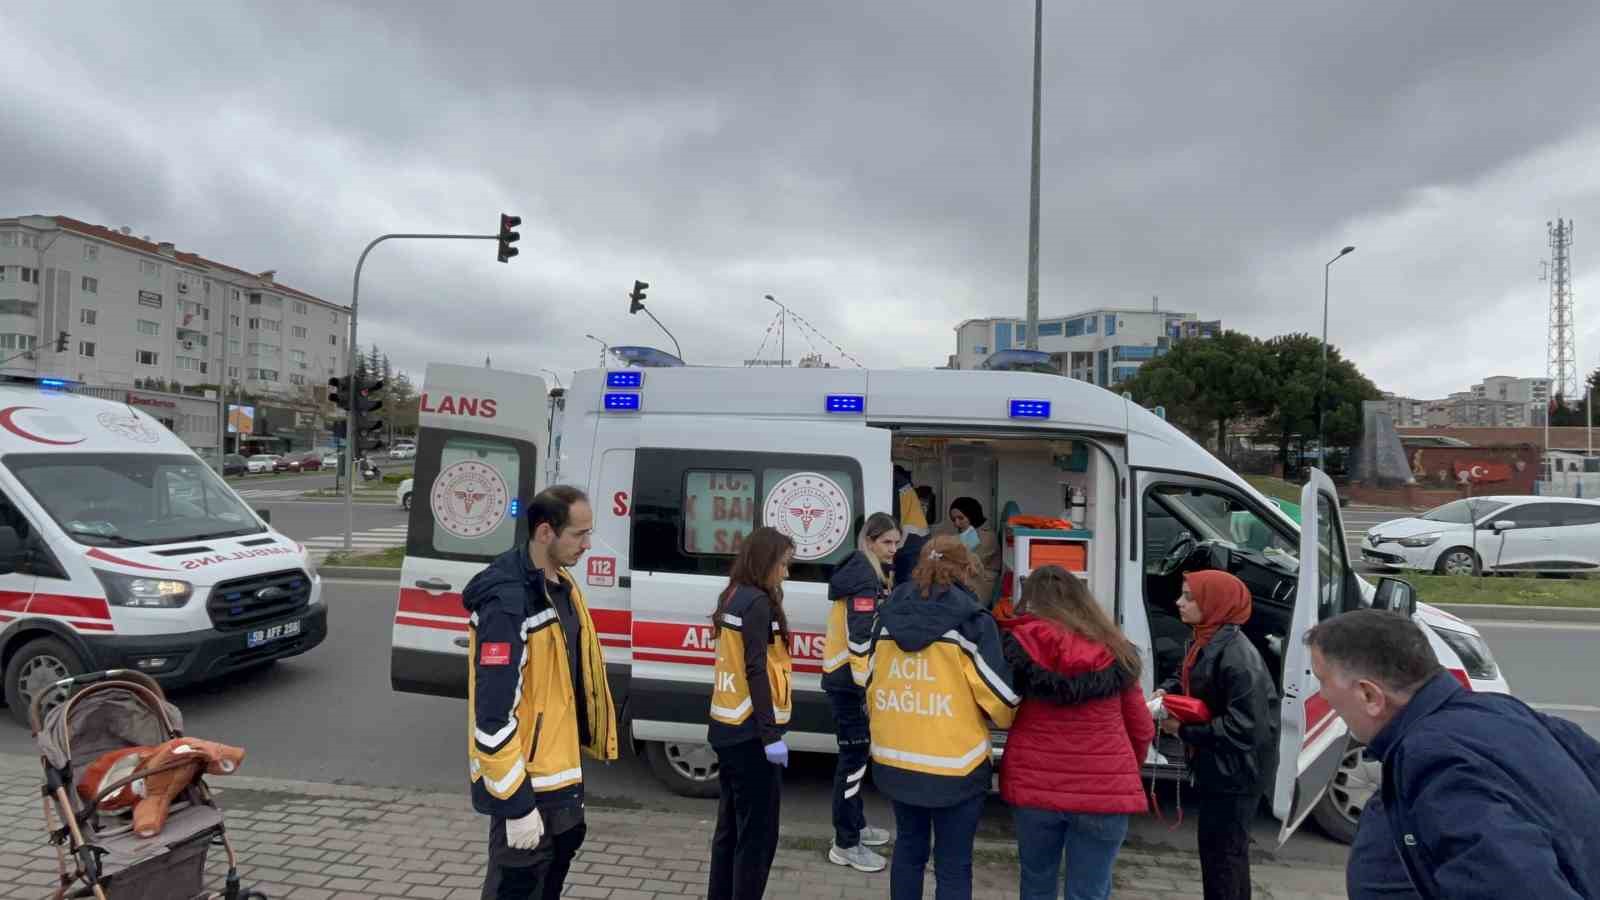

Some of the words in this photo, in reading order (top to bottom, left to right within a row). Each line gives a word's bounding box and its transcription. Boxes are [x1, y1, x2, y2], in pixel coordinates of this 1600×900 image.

[591, 560, 611, 575] 112
[888, 653, 937, 683] ACİL
[875, 681, 953, 718] SAĞLIK
